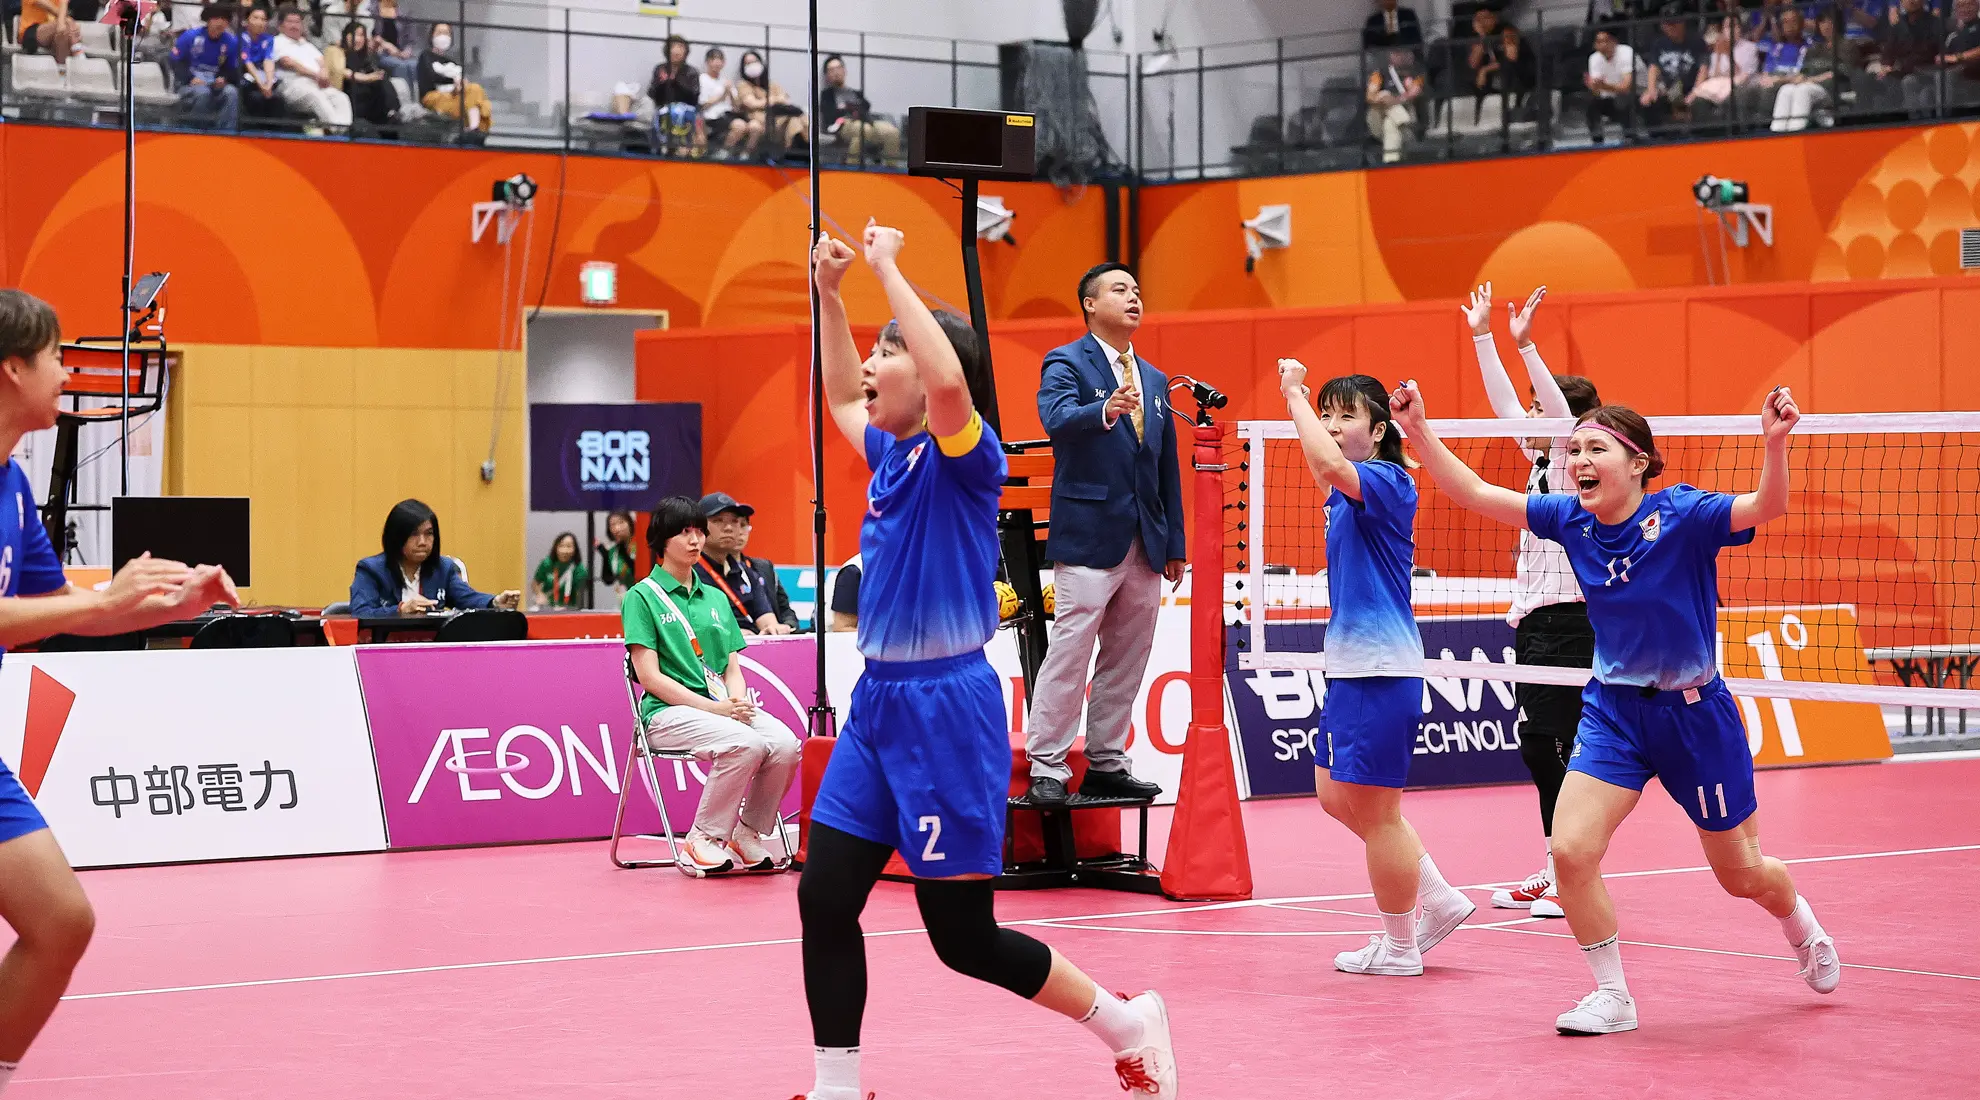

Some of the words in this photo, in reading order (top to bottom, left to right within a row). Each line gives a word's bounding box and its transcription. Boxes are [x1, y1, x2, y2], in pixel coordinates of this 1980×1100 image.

[576, 430, 651, 457] BOR
[580, 457, 651, 482] NAN
[1605, 556, 1632, 587] 11
[1412, 719, 1522, 755] ECHNOL
[90, 760, 299, 819] 中部電力
[1697, 783, 1728, 819] 11
[918, 815, 946, 862] 2
